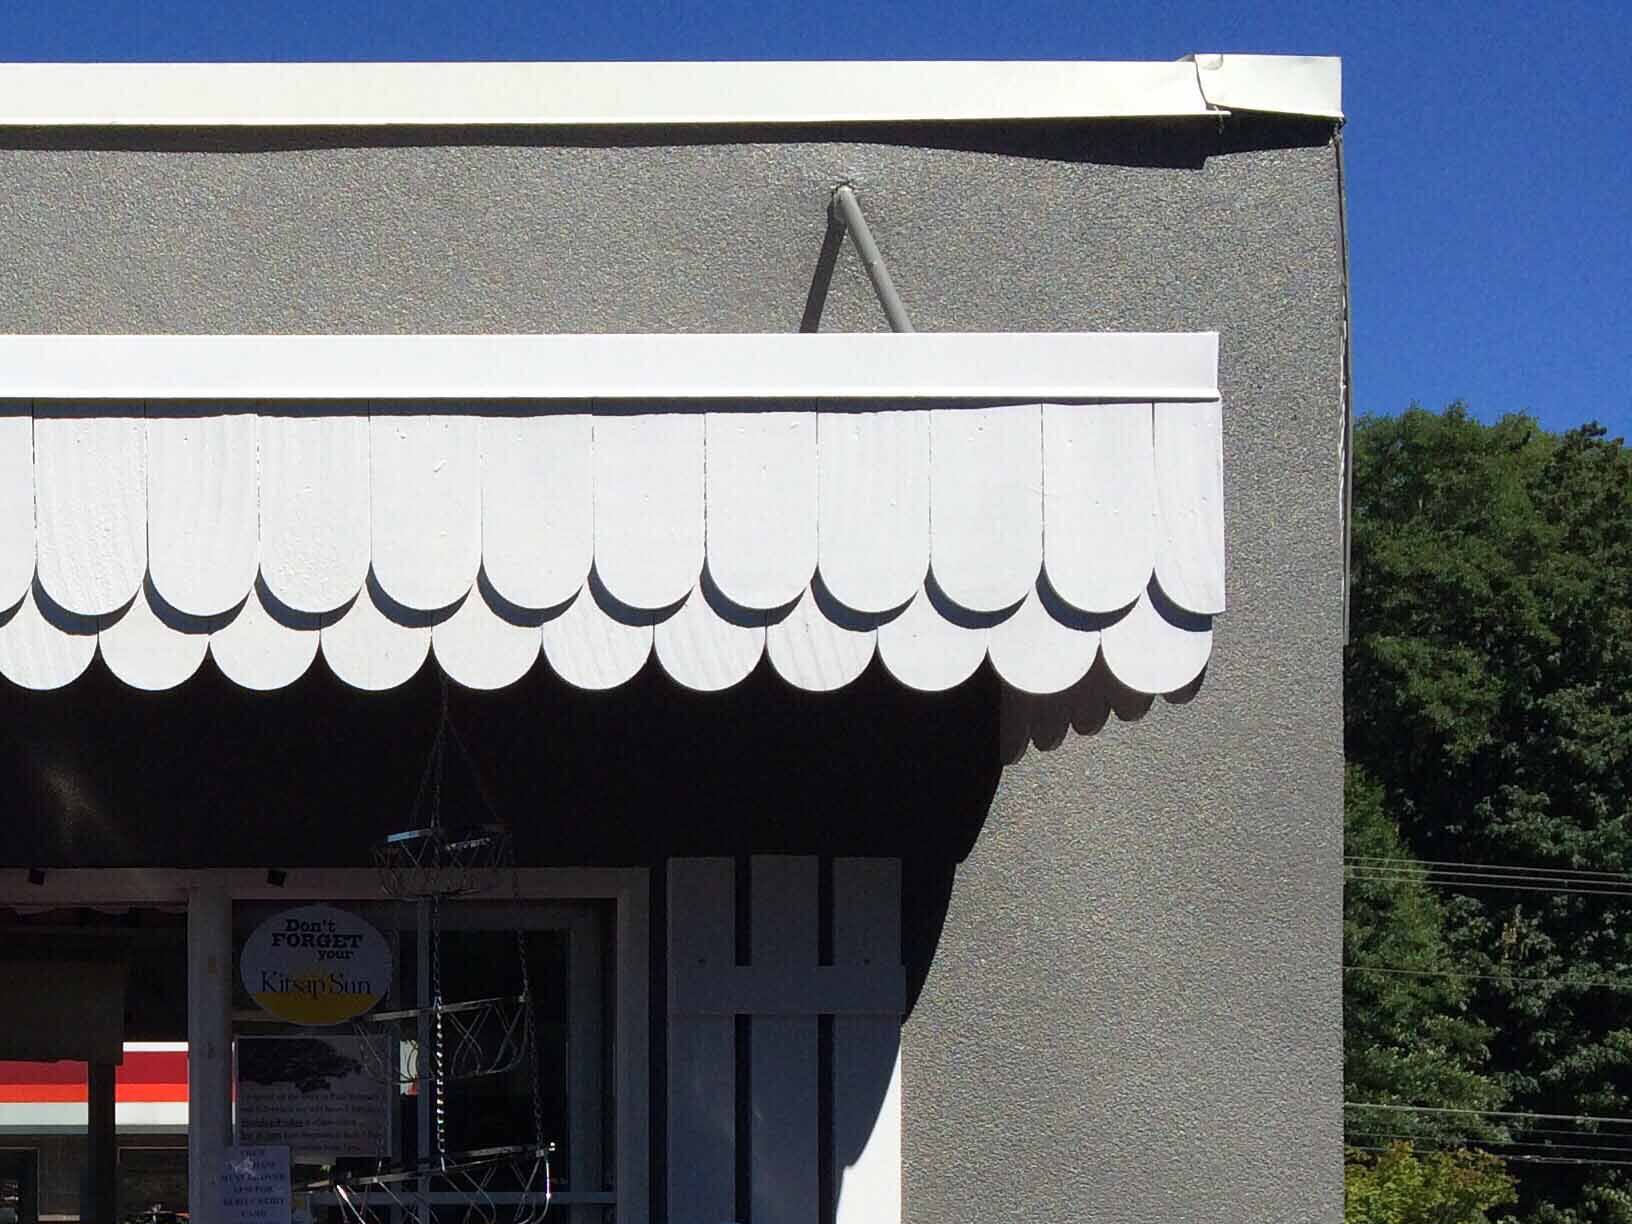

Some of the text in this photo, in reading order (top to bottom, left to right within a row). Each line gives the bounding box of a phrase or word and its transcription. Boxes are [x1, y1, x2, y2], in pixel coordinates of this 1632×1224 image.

[285, 918, 337, 933] Don't
[271, 933, 363, 949] FORGET
[317, 949, 355, 961] your
[260, 970, 372, 1000] Kitsap Sun
